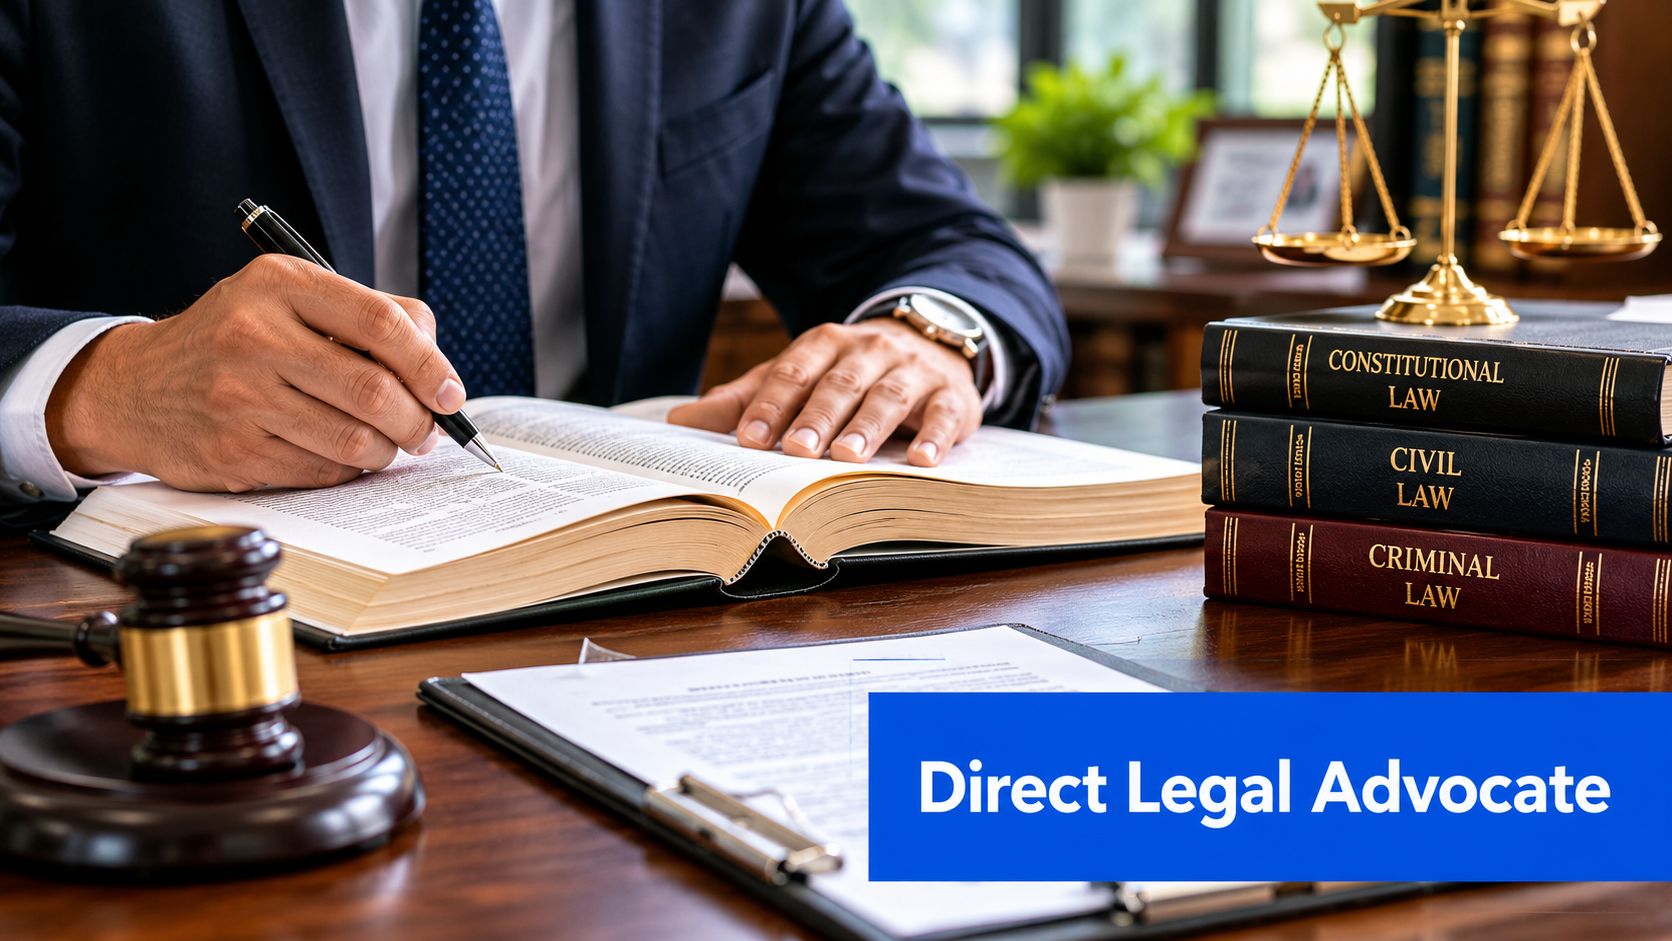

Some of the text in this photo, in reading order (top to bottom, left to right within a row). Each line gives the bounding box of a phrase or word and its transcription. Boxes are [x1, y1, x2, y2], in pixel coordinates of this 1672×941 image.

[1328, 349, 1505, 384] CONSTITUTIONAL
[1388, 385, 1441, 412] LAW
[1390, 446, 1462, 477] CIVIL
[1397, 482, 1455, 510] LAW
[1368, 543, 1500, 580] CRIMINAL
[1404, 582, 1462, 610] LAW
